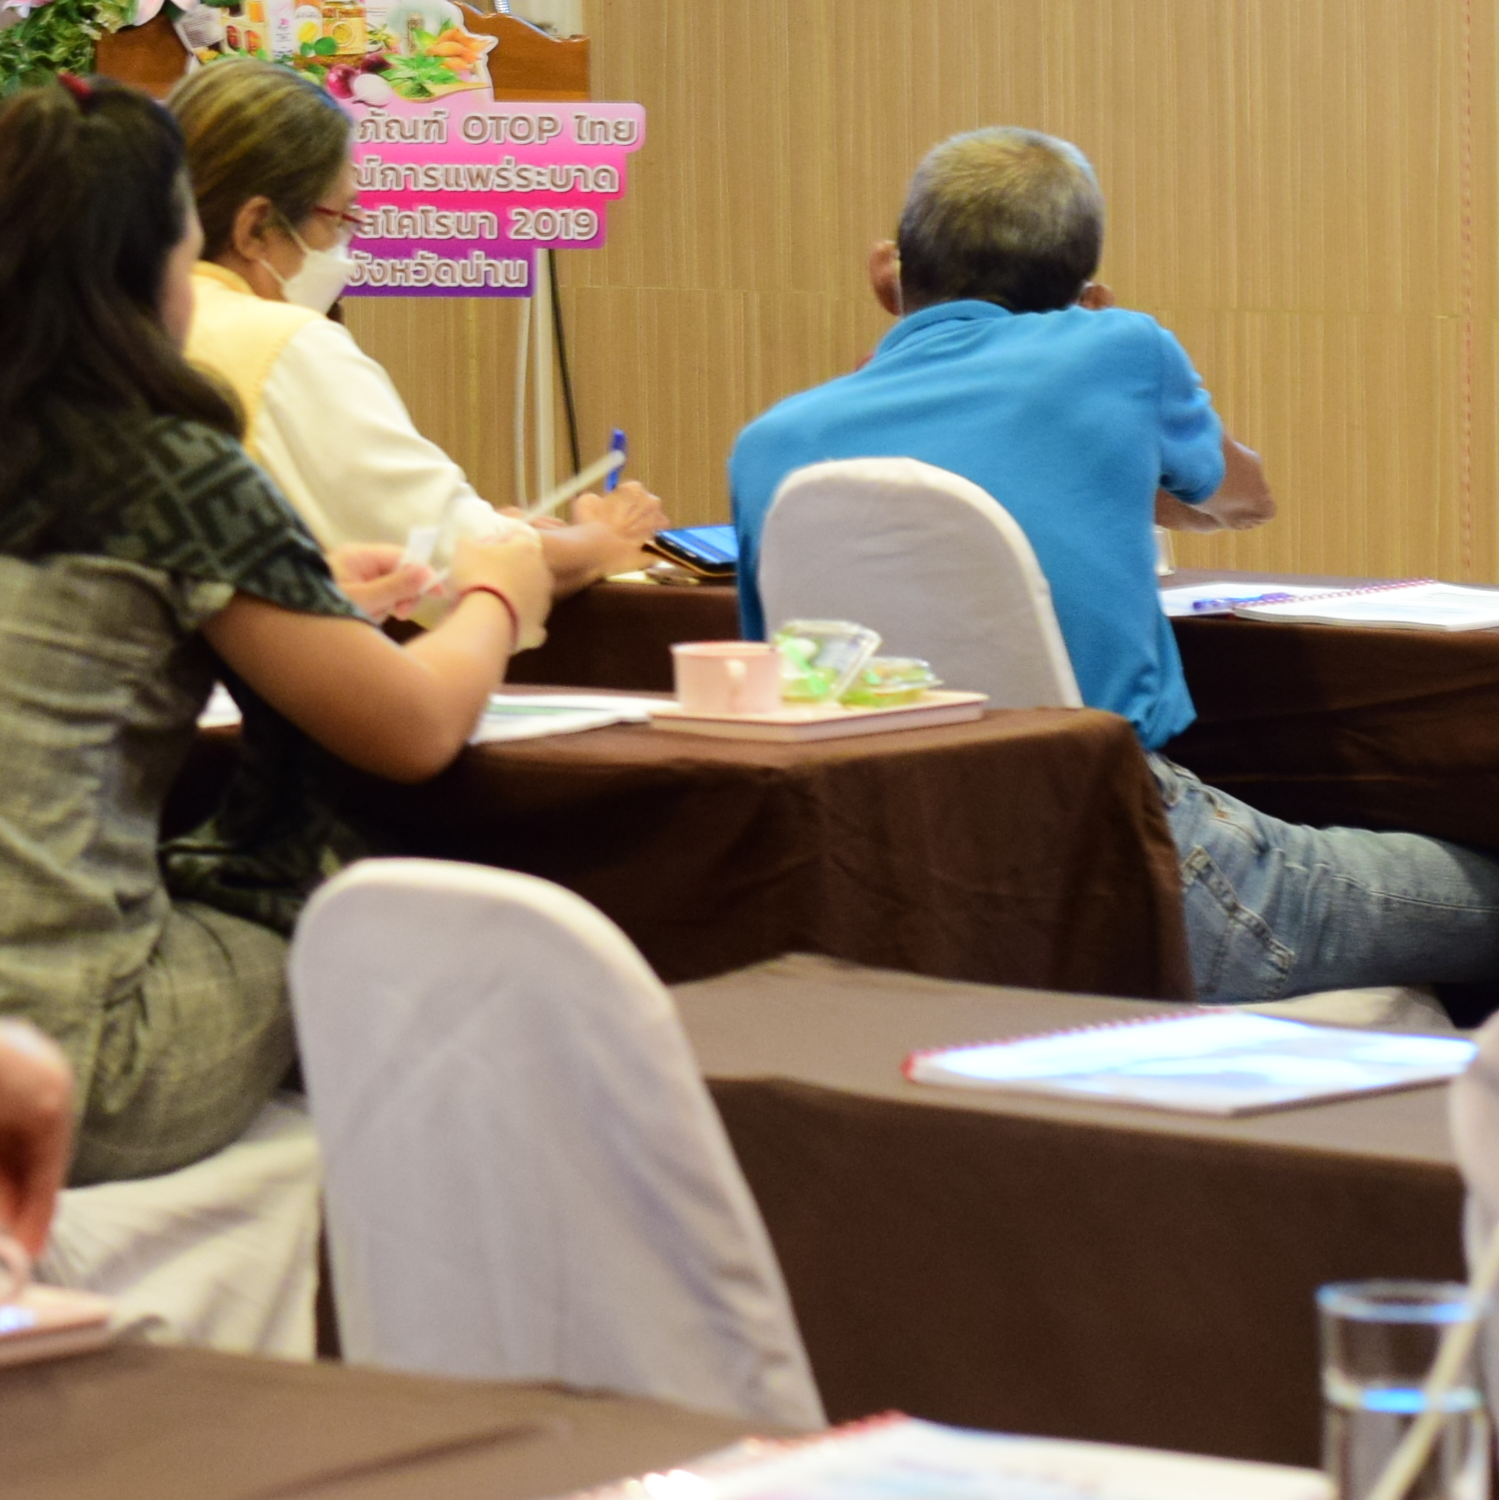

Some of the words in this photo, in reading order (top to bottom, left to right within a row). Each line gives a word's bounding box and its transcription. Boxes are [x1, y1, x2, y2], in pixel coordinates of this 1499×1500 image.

[461, 114, 562, 144] OTOP
[573, 112, 639, 144] ไทย
[510, 208, 600, 240] 2019
